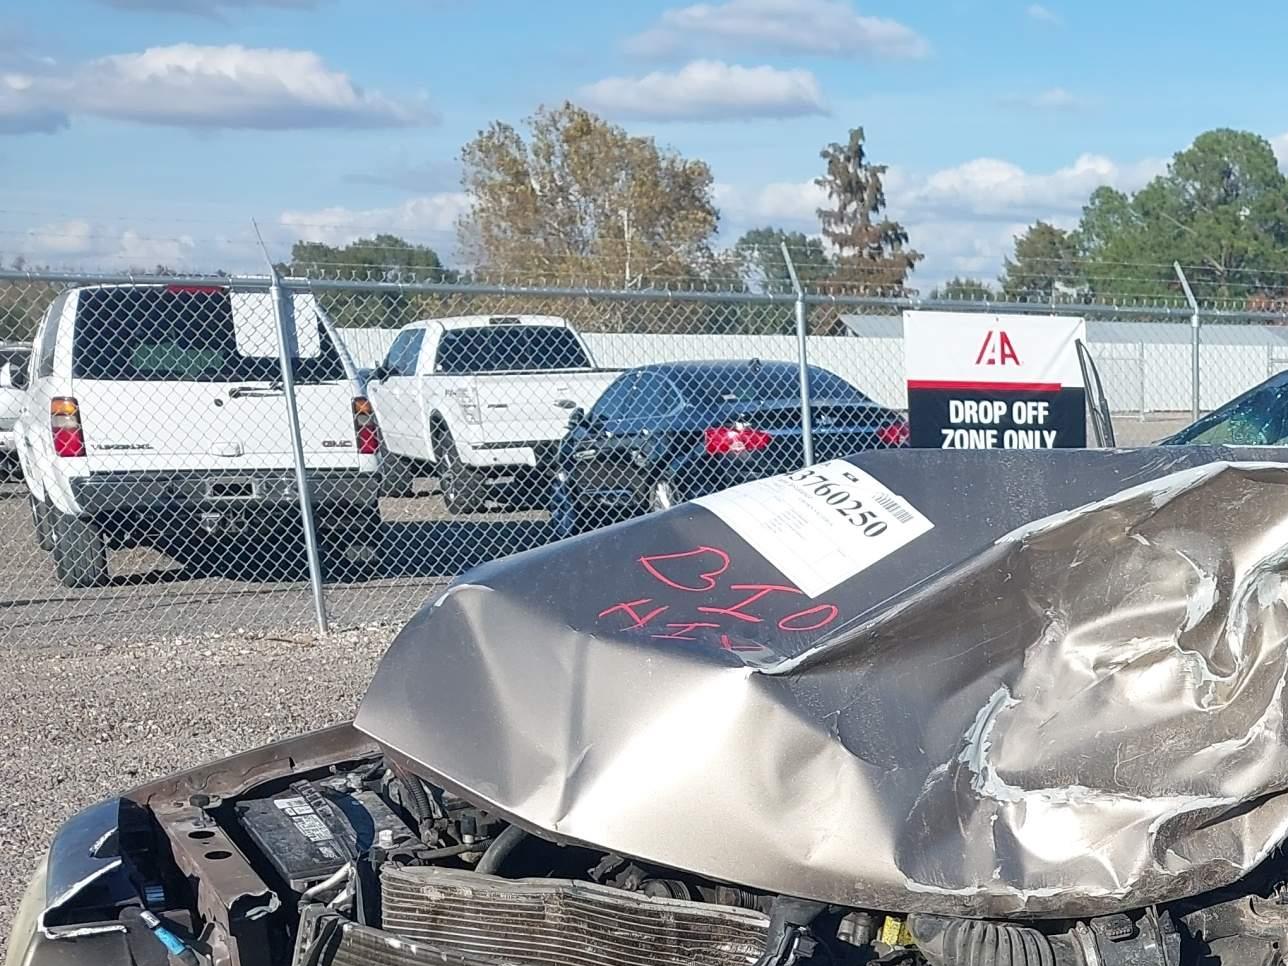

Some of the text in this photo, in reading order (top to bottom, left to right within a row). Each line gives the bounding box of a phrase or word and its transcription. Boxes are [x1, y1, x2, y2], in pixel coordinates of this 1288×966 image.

[941, 419, 1057, 449] ZONE ONLY
[950, 400, 1049, 425] DROP OFF
[783, 470, 888, 537] 3760250
[637, 546, 839, 631] BIO
